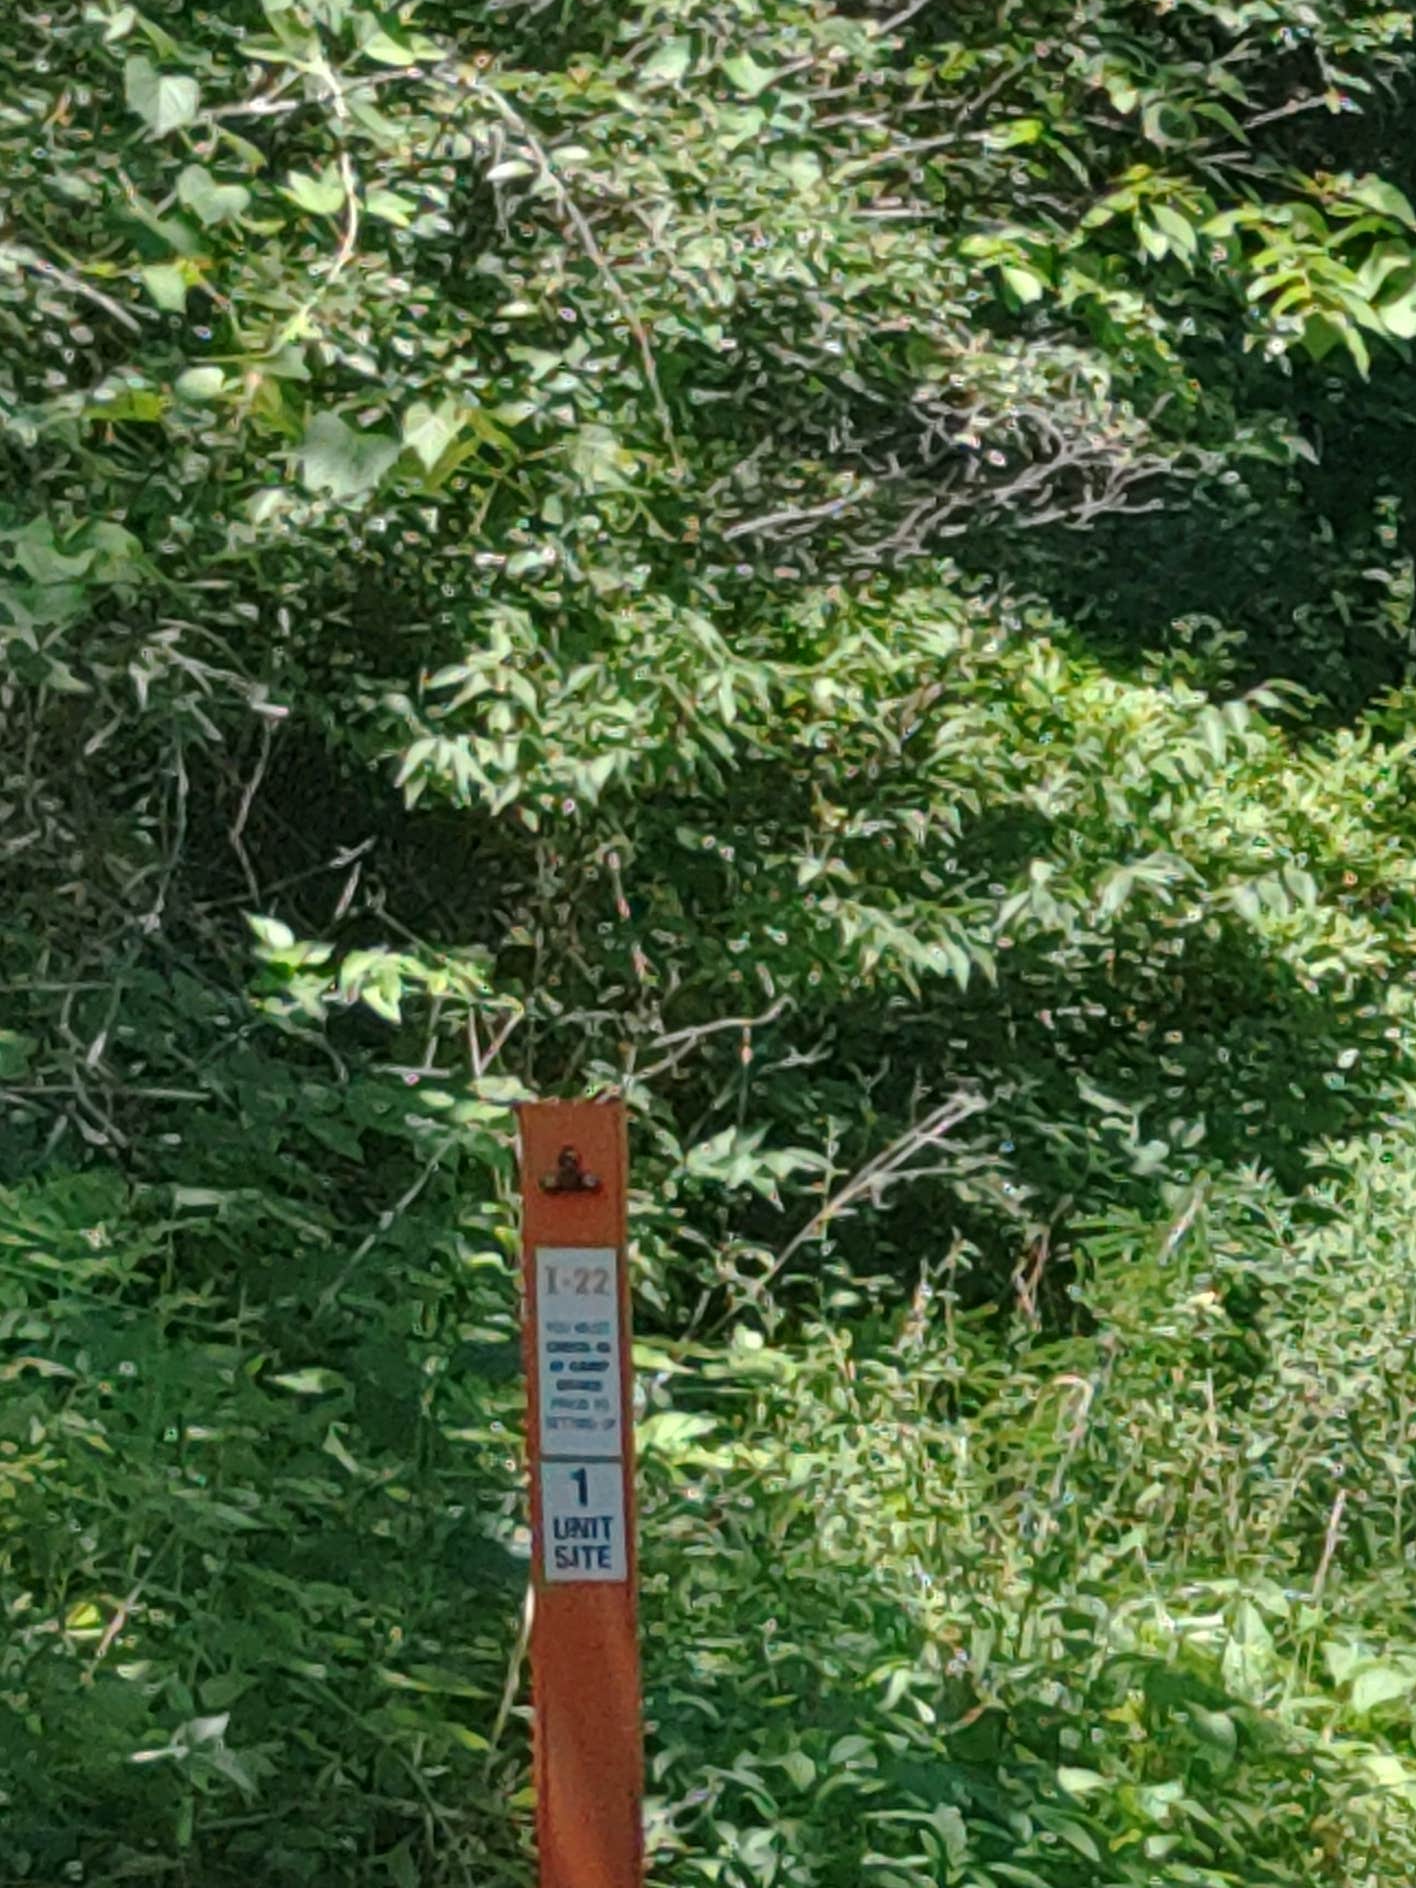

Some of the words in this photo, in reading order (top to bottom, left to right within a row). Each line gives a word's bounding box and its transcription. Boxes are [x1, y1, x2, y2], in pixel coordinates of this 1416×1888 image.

[570, 1468, 589, 1507] 1
[553, 1516, 613, 1541] UNIT
[555, 1545, 612, 1569] SITE
